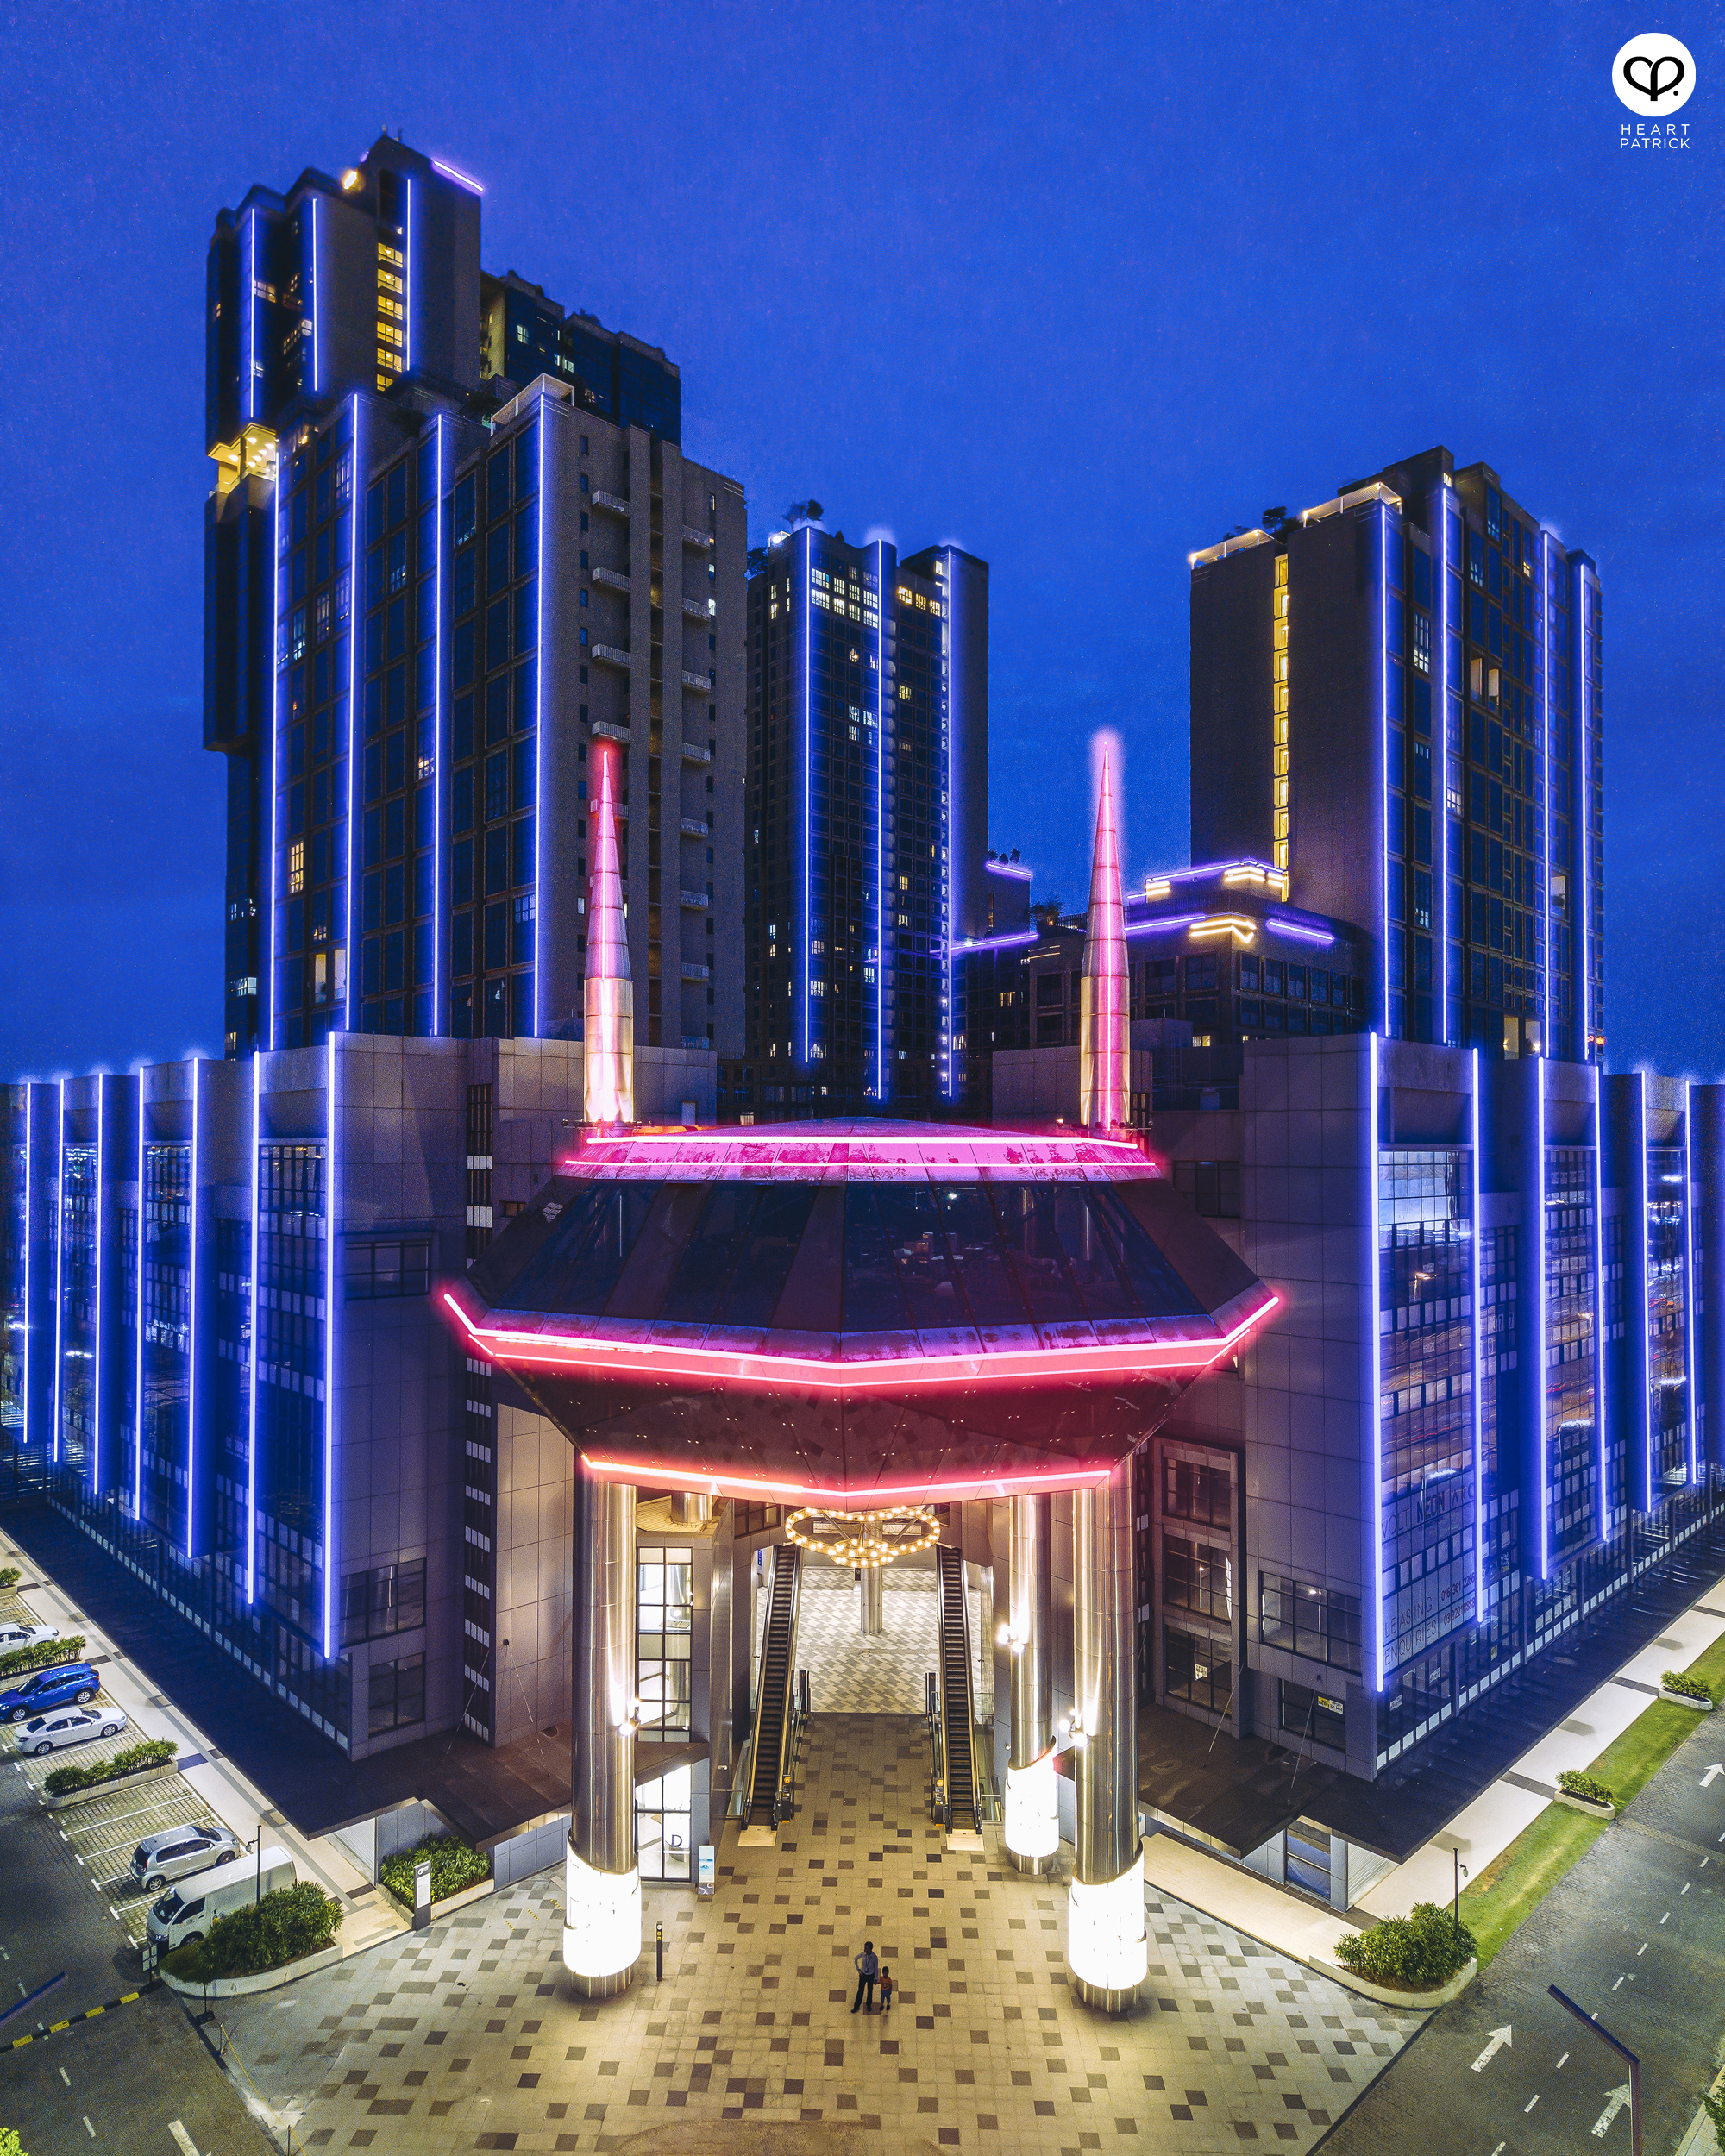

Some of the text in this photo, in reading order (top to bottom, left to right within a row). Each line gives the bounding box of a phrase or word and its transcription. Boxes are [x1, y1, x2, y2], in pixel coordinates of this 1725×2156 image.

[1416, 1490, 1445, 1523] NEON
[1384, 1596, 1432, 1639] LEASING
[1384, 1620, 1437, 1666] ENQUIRIES
